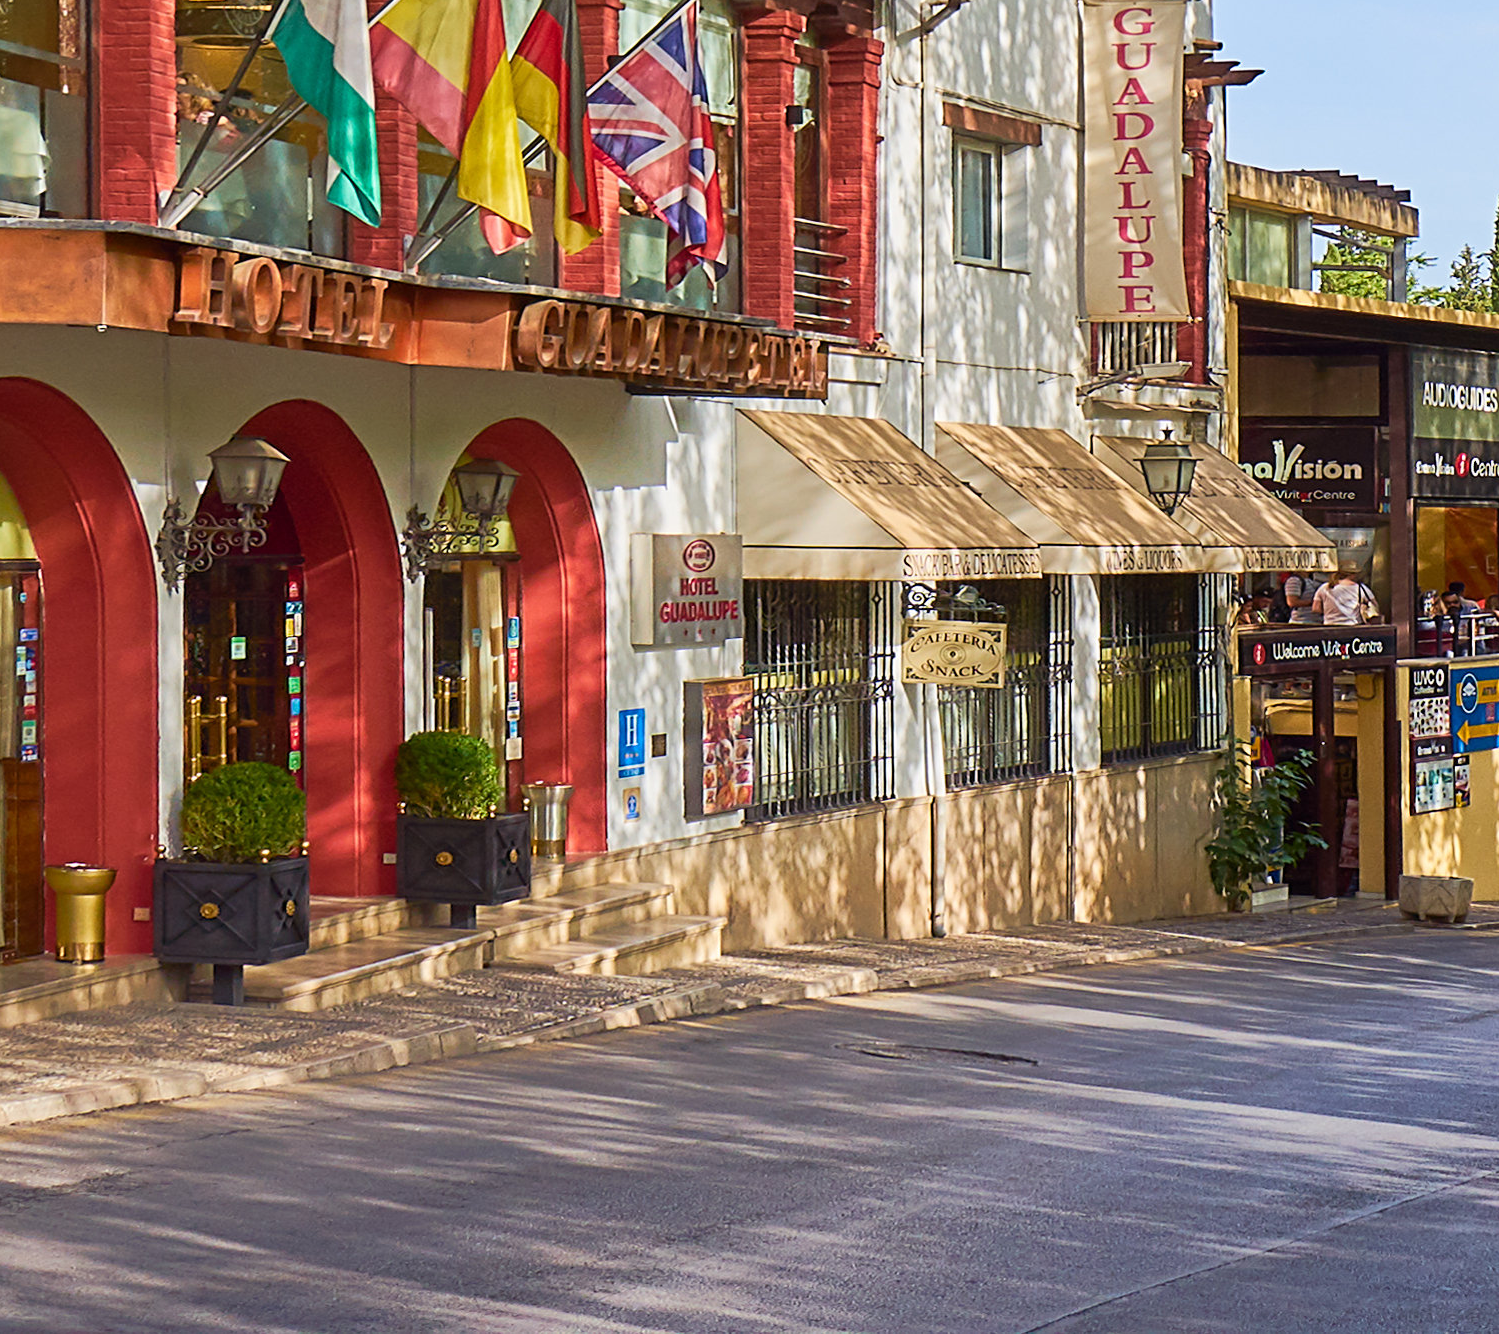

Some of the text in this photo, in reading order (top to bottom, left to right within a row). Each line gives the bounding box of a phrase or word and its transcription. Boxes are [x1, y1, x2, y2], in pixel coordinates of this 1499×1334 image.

[1112, 7, 1155, 314] GUADALUPE
[174, 246, 762, 389] HOTEL GUADALUPE
[1422, 381, 1499, 413] AUDIOGUIDES
[1313, 489, 1356, 500] Centre
[903, 553, 940, 577] SNACK
[942, 553, 961, 577] BAR
[1145, 550, 1183, 572] LIQUORS
[679, 577, 719, 596] HOTEL
[659, 599, 739, 624] GUADALUPE
[910, 632, 996, 656] CAFETERIA
[1272, 641, 1321, 661] Welcome
[1352, 637, 1384, 655] Centre
[920, 658, 983, 678] SNACK
[624, 713, 639, 747] H
